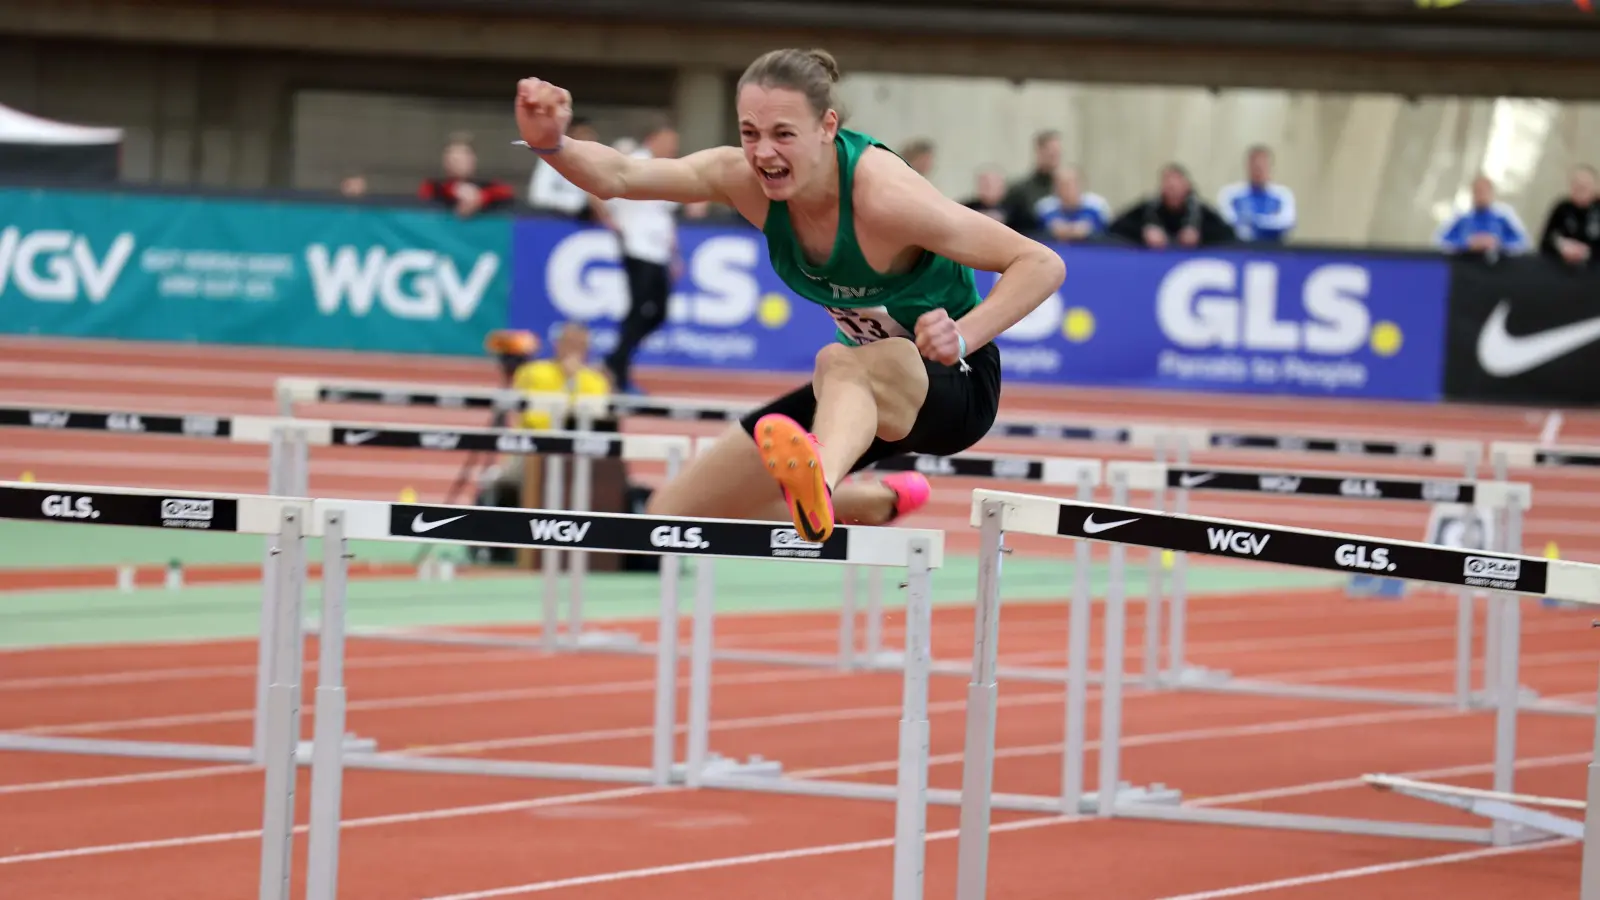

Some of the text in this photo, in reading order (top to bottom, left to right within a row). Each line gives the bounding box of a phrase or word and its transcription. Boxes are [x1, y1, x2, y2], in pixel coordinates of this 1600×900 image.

[306, 242, 499, 321] WGV
[41, 494, 100, 519] GLS.
[529, 518, 591, 543] WGV
[650, 525, 710, 549] GLS.
[1207, 527, 1271, 556] WGV
[1334, 543, 1397, 572] GLS.
